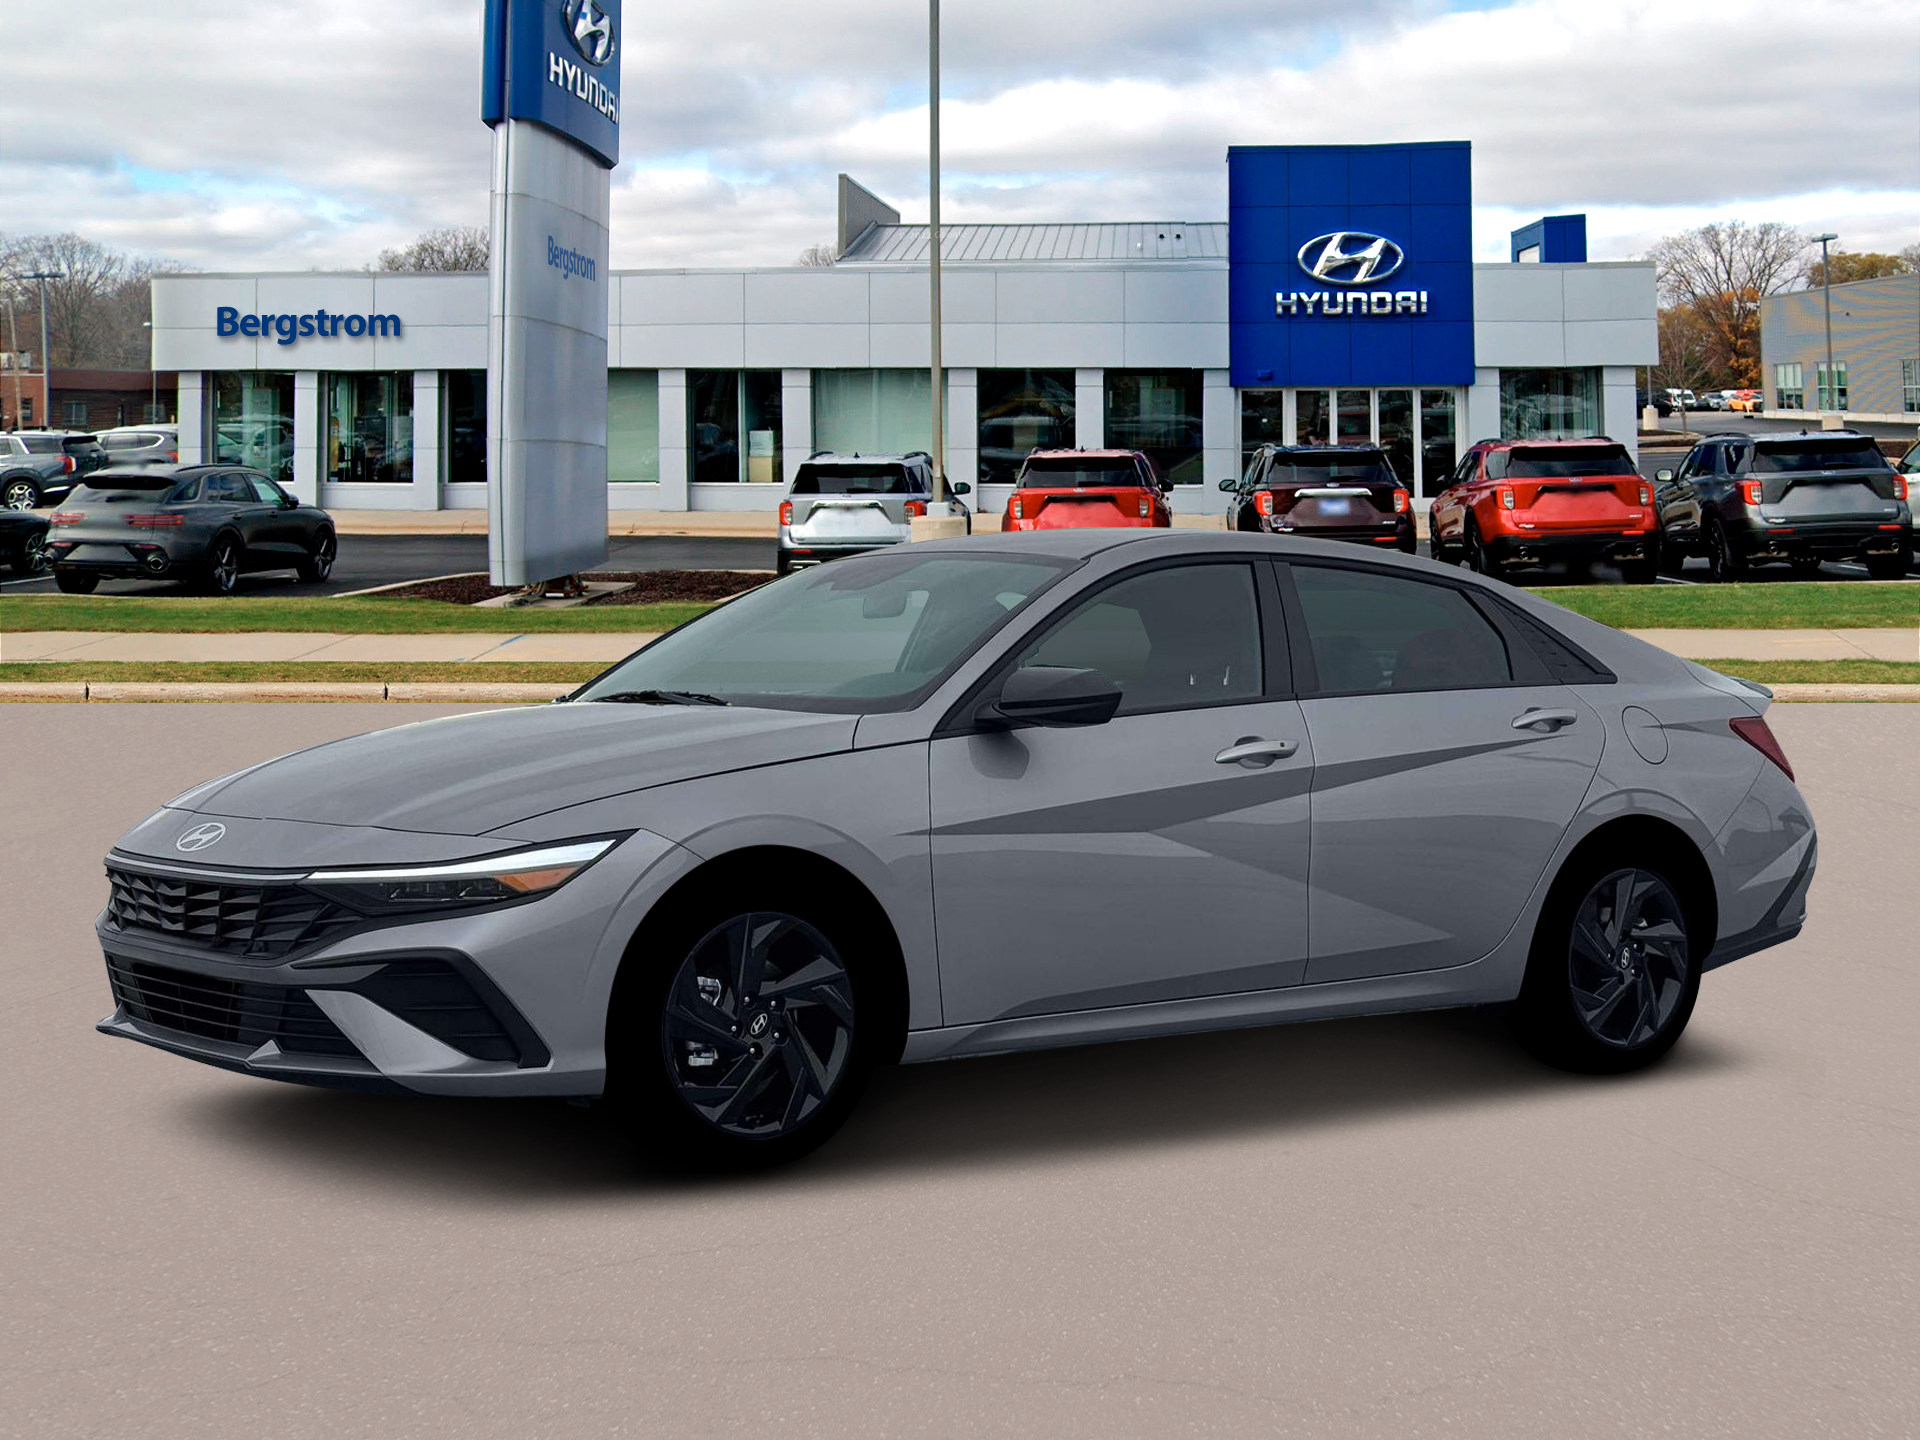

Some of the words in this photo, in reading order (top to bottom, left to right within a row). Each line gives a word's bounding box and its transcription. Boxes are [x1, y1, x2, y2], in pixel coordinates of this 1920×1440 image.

[549, 52, 618, 124] HYUNDAI
[548, 235, 595, 281] Bergstrom
[1275, 291, 1428, 315] HYUNDAI
[216, 306, 401, 346] Bergstrom
